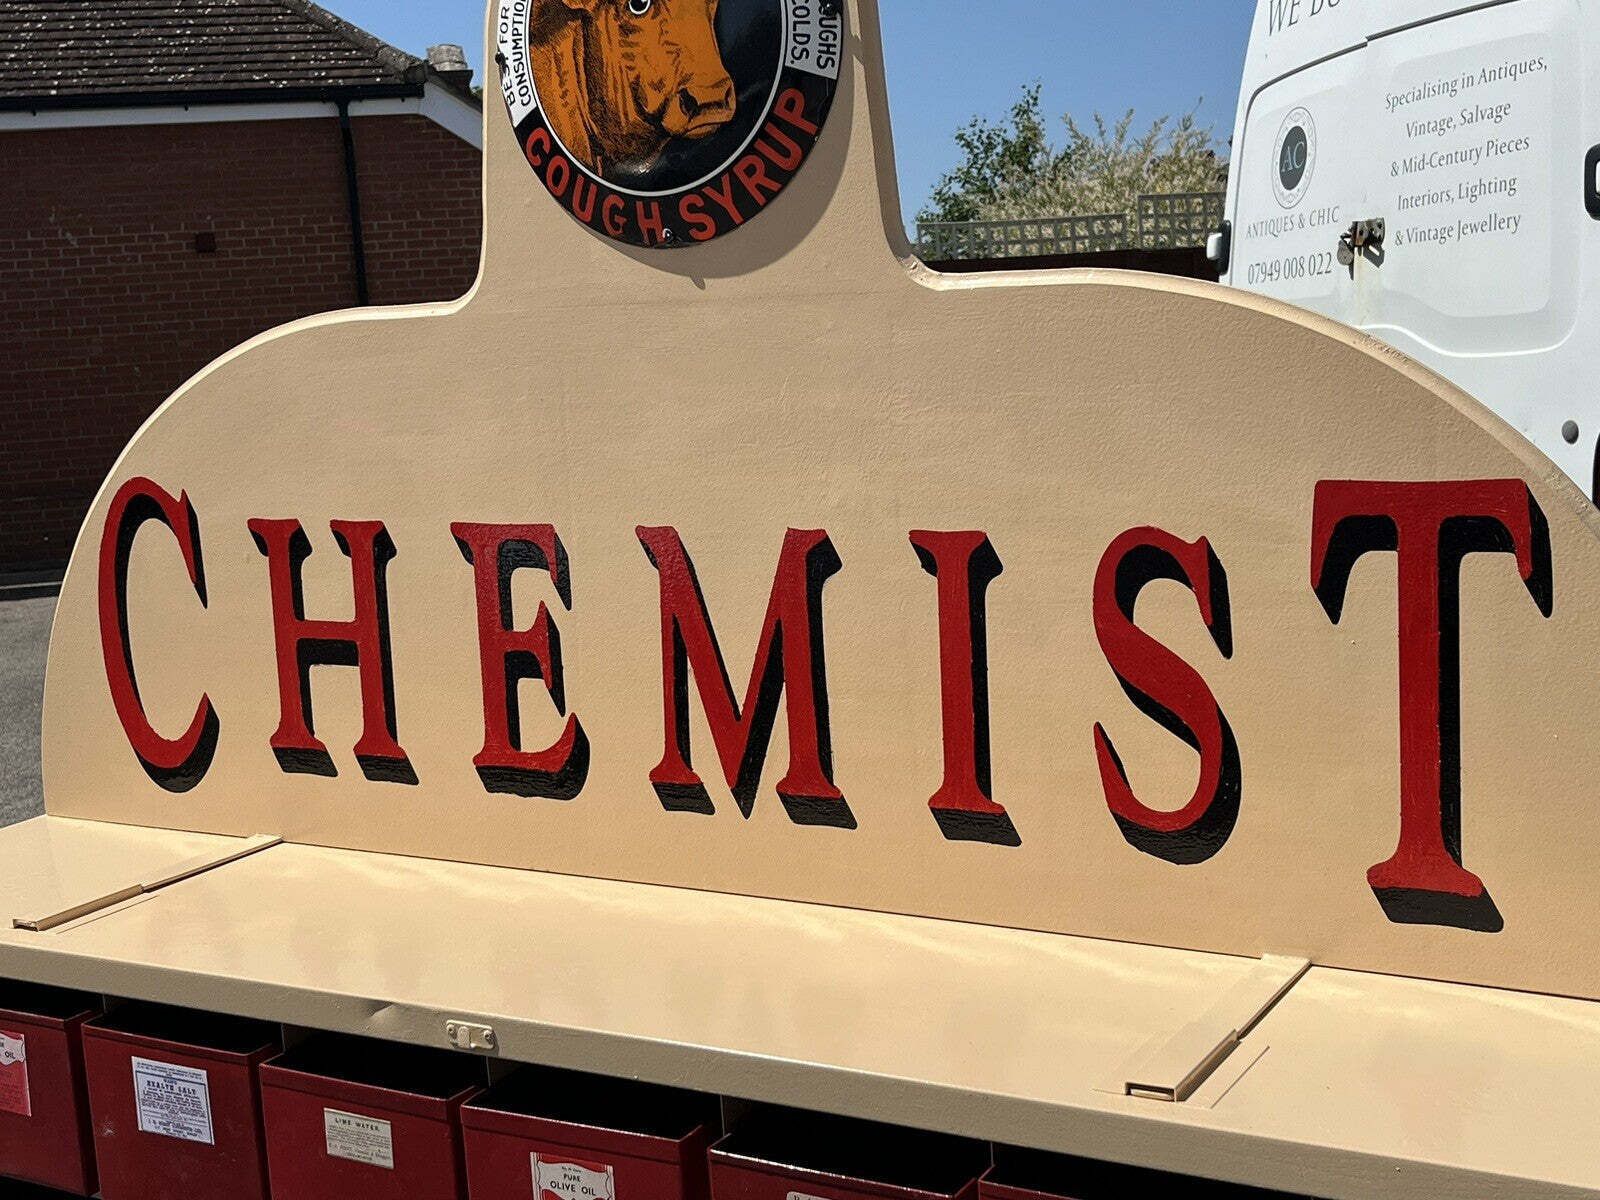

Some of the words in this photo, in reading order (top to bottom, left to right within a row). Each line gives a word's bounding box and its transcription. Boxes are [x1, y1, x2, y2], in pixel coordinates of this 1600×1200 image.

[499, 6, 511, 44] FOR
[511, 0, 532, 107] CONSUMPTIO
[498, 55, 516, 107] BES
[1385, 79, 1458, 113] Specialising
[1461, 72, 1475, 90] in
[1477, 56, 1548, 85] Antiques,
[1405, 115, 1457, 138] Vintage,
[1460, 102, 1512, 126] Salvage
[525, 126, 666, 244] COUGH
[678, 87, 819, 241] SYRUP
[1390, 161, 1400, 177] &
[1402, 145, 1483, 175] Mid-Century
[1486, 135, 1530, 158] Pieces
[1397, 188, 1455, 211] Interiors,
[1458, 176, 1518, 204] Lighting
[1245, 214, 1295, 238] ANTIQUES
[1298, 213, 1305, 229] &
[1309, 206, 1340, 227] CHIC
[1394, 230, 1403, 246] &
[1405, 223, 1455, 245] Vintage
[1457, 211, 1522, 242] Jewellery
[1247, 259, 1281, 286] 07949
[1283, 255, 1305, 280] 008
[1308, 251, 1332, 276] 022
[98, 476, 1553, 933] CHEMIST
[549, 1180, 576, 1193] OLIVE
[581, 1186, 597, 1196] OIL
[563, 1173, 581, 1183] PURE
